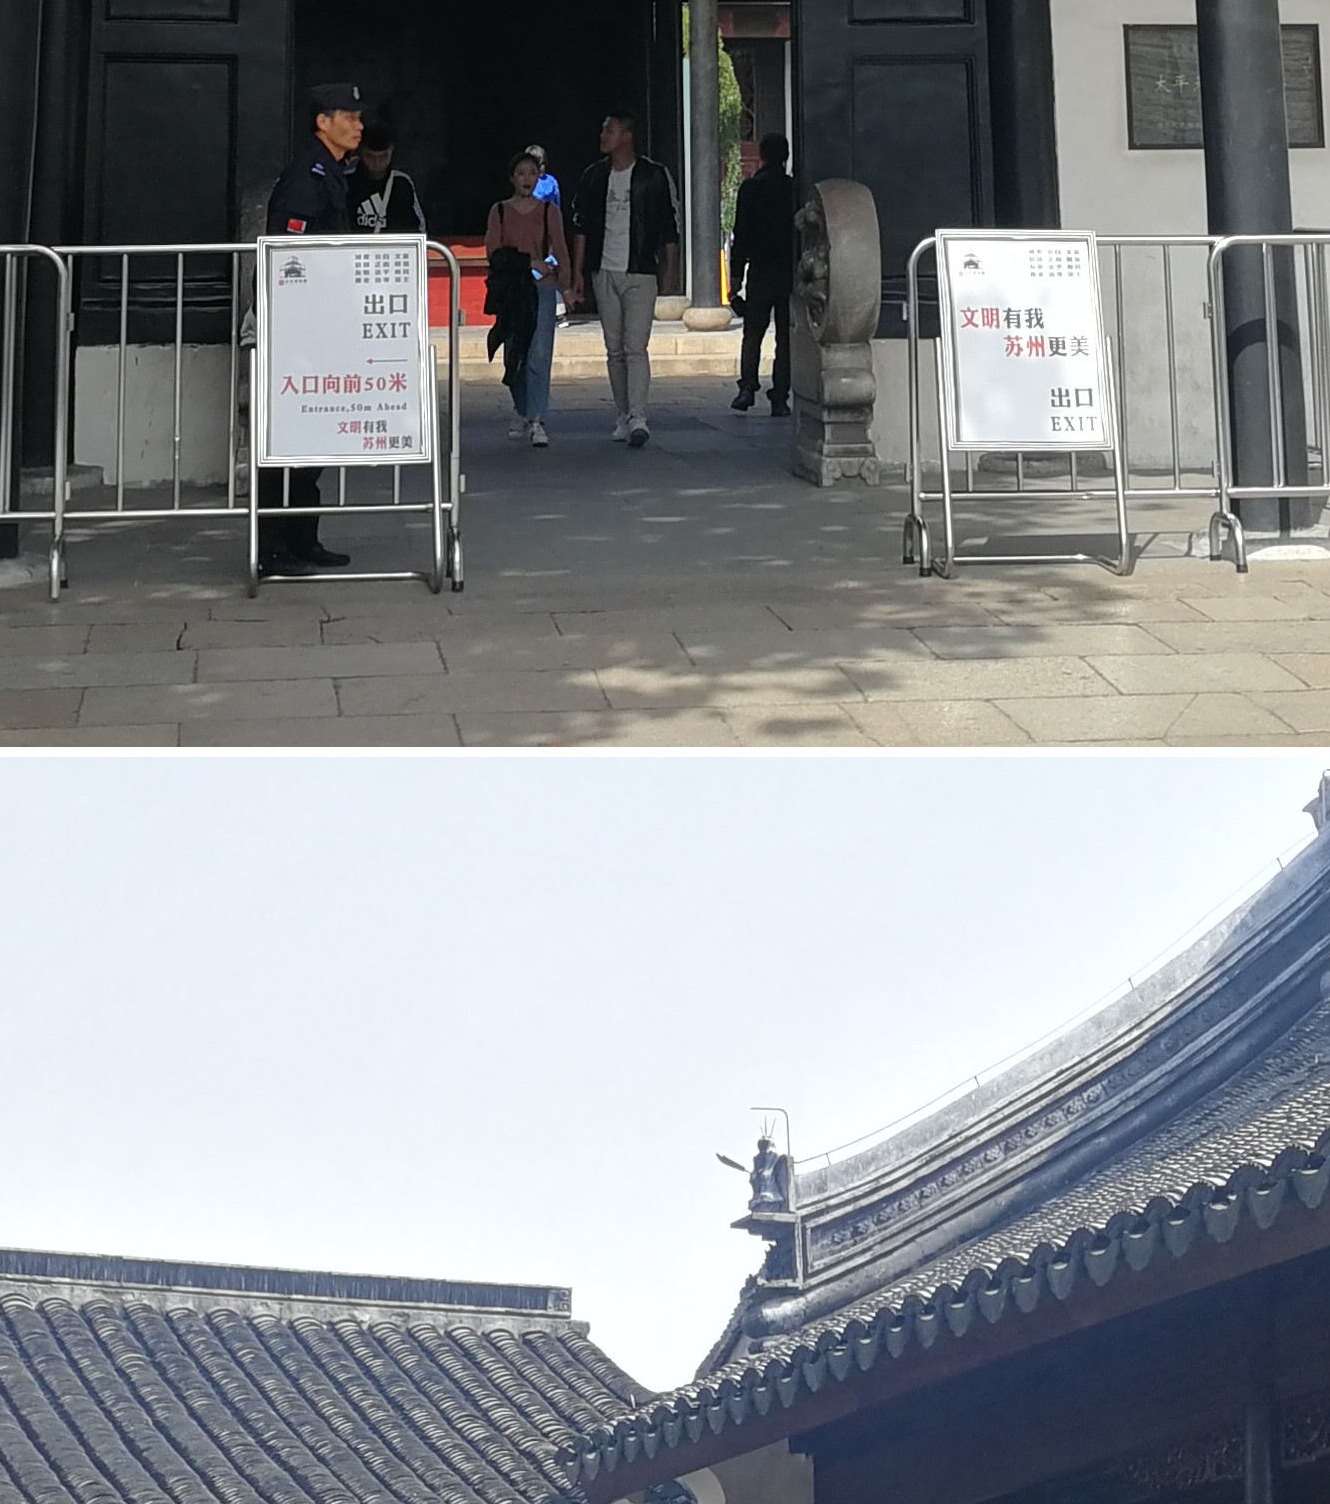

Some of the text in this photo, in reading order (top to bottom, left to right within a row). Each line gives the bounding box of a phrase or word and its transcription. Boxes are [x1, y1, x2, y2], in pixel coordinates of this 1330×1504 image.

[363, 293, 408, 315] 出口
[959, 306, 1045, 330] 文明有我
[362, 322, 411, 339] EXIT
[1003, 335, 1089, 358] 苏州更美
[280, 372, 408, 395] 入口向前50米
[376, 402, 407, 412] Ahead
[1050, 387, 1094, 408] 出口
[337, 420, 388, 434] 文明有我
[1050, 416, 1097, 432] EXIT
[363, 435, 413, 450] 苏州更美
